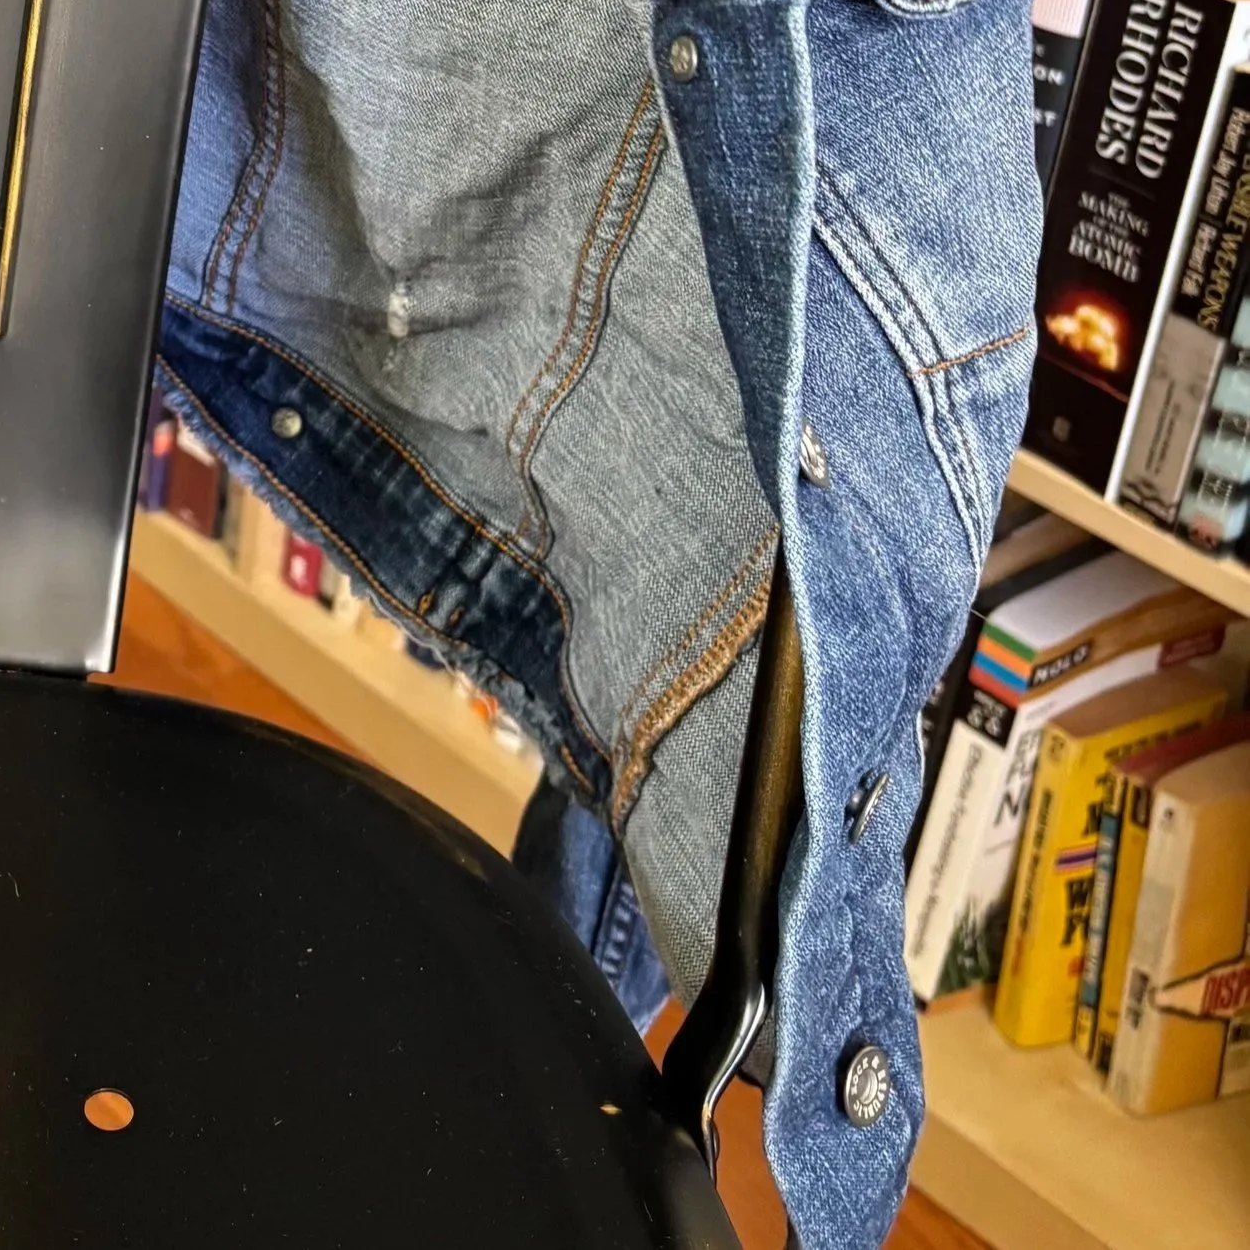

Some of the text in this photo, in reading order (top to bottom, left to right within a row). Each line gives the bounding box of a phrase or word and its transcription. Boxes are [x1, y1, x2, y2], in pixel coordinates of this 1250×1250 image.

[1135, 1, 1205, 179] RICHARD
[1078, 191, 1150, 237] MAKING
[1069, 234, 1139, 282] BOMB
[1197, 232, 1243, 332] WEAPONS
[851, 1057, 869, 1095] ROCK
